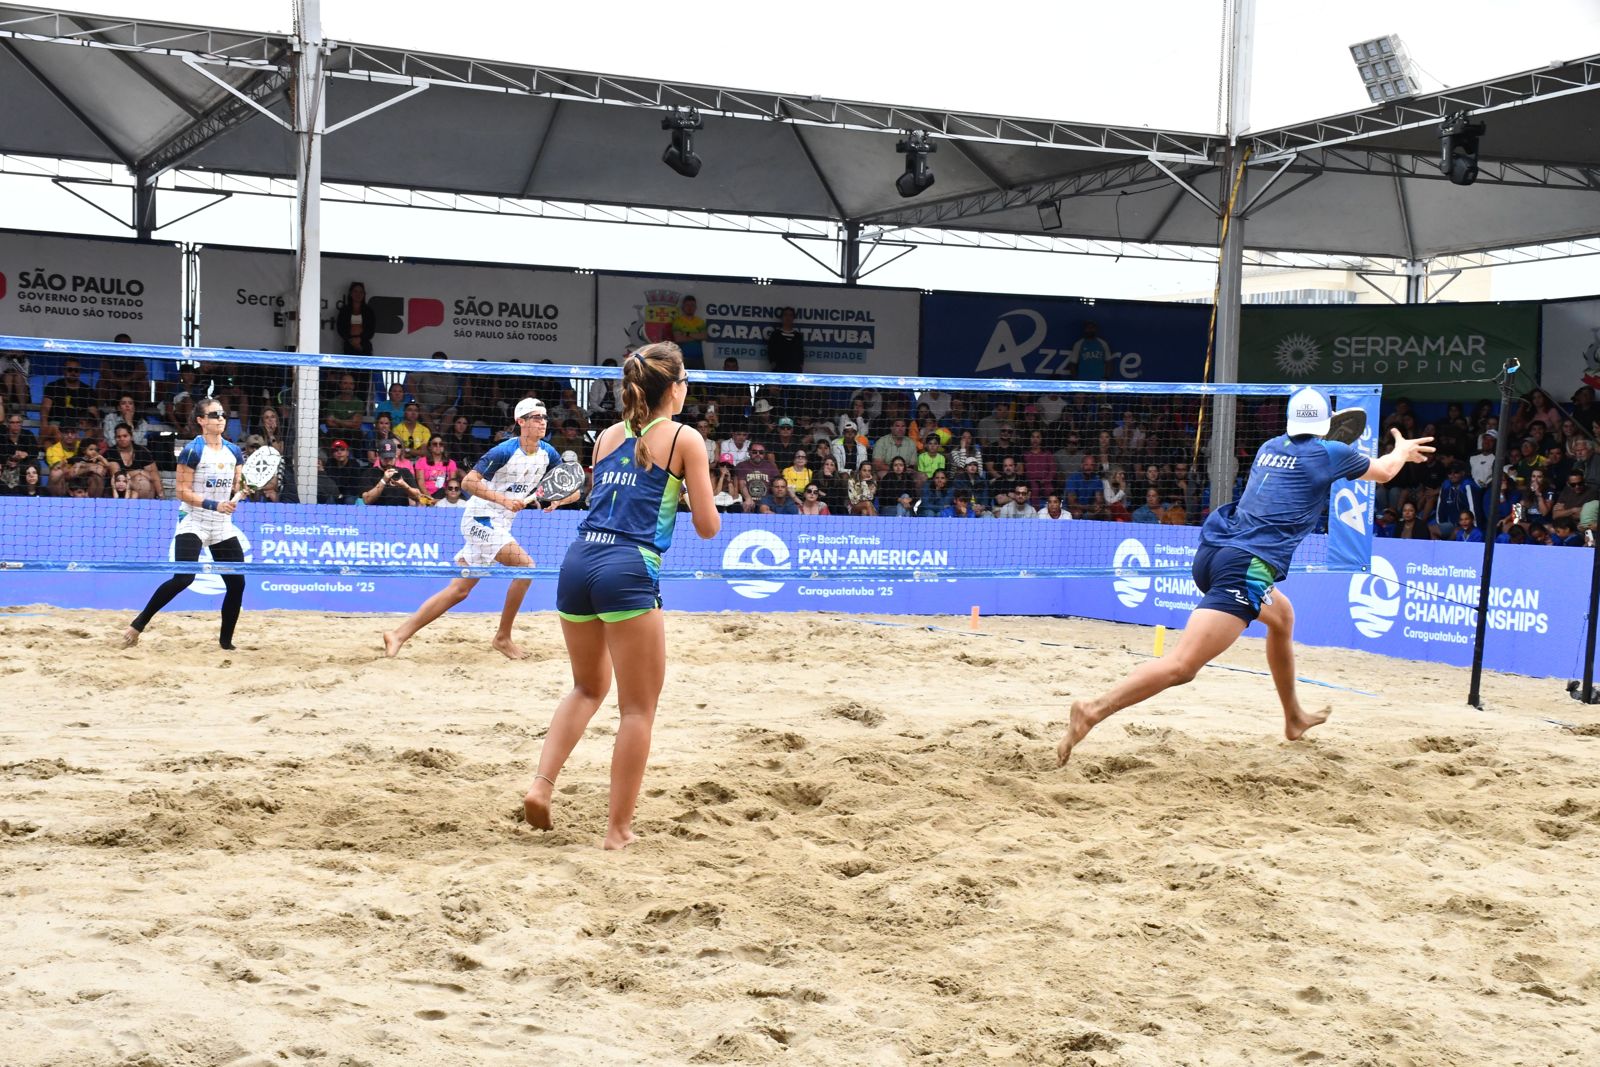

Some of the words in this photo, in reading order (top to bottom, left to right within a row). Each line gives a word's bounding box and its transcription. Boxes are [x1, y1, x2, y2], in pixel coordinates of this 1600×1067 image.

[19, 268, 66, 291] SÃO
[72, 275, 144, 297] PAULO
[17, 291, 77, 303] GOVERNO
[81, 296, 97, 304] DO
[101, 297, 143, 308] ESTADO
[19, 303, 41, 314] SÃO
[45, 306, 79, 316] PAULO
[83, 307, 104, 318] SÃO
[107, 310, 143, 320] TODOS
[454, 296, 494, 317] SÃO
[498, 302, 559, 320] PAULO
[706, 304, 784, 319] GOVERNO
[453, 318, 502, 328] GOVERNO
[505, 320, 519, 328] DO
[522, 321, 558, 330] ESTADO
[454, 328, 472, 338] SÃO
[475, 330, 504, 340] PAULO
[506, 331, 525, 341] SÃO
[528, 333, 558, 342] TODOS
[717, 346, 757, 357] TEMPO
[1333, 335, 1486, 357] SERRAMAR
[1332, 359, 1486, 374] SHOPPING
[1296, 409, 1318, 418] HAVAN
[1257, 453, 1298, 470] BRASIL
[602, 471, 637, 487] BRASIL
[284, 524, 320, 535] Beach
[321, 525, 359, 536] Tennis
[585, 531, 616, 545] BRASIL
[817, 534, 848, 545] Beach
[849, 535, 880, 545] Tennis
[261, 540, 439, 560] PAN-AMERICAN
[798, 549, 948, 566] PAN-AMERICAN
[1421, 563, 1448, 577] Beach
[1448, 565, 1477, 579] Tennis
[261, 581, 352, 593] Caraguatatuba
[798, 586, 874, 598] Caraguatatuba
[1403, 626, 1468, 645] Caraguatatuba
